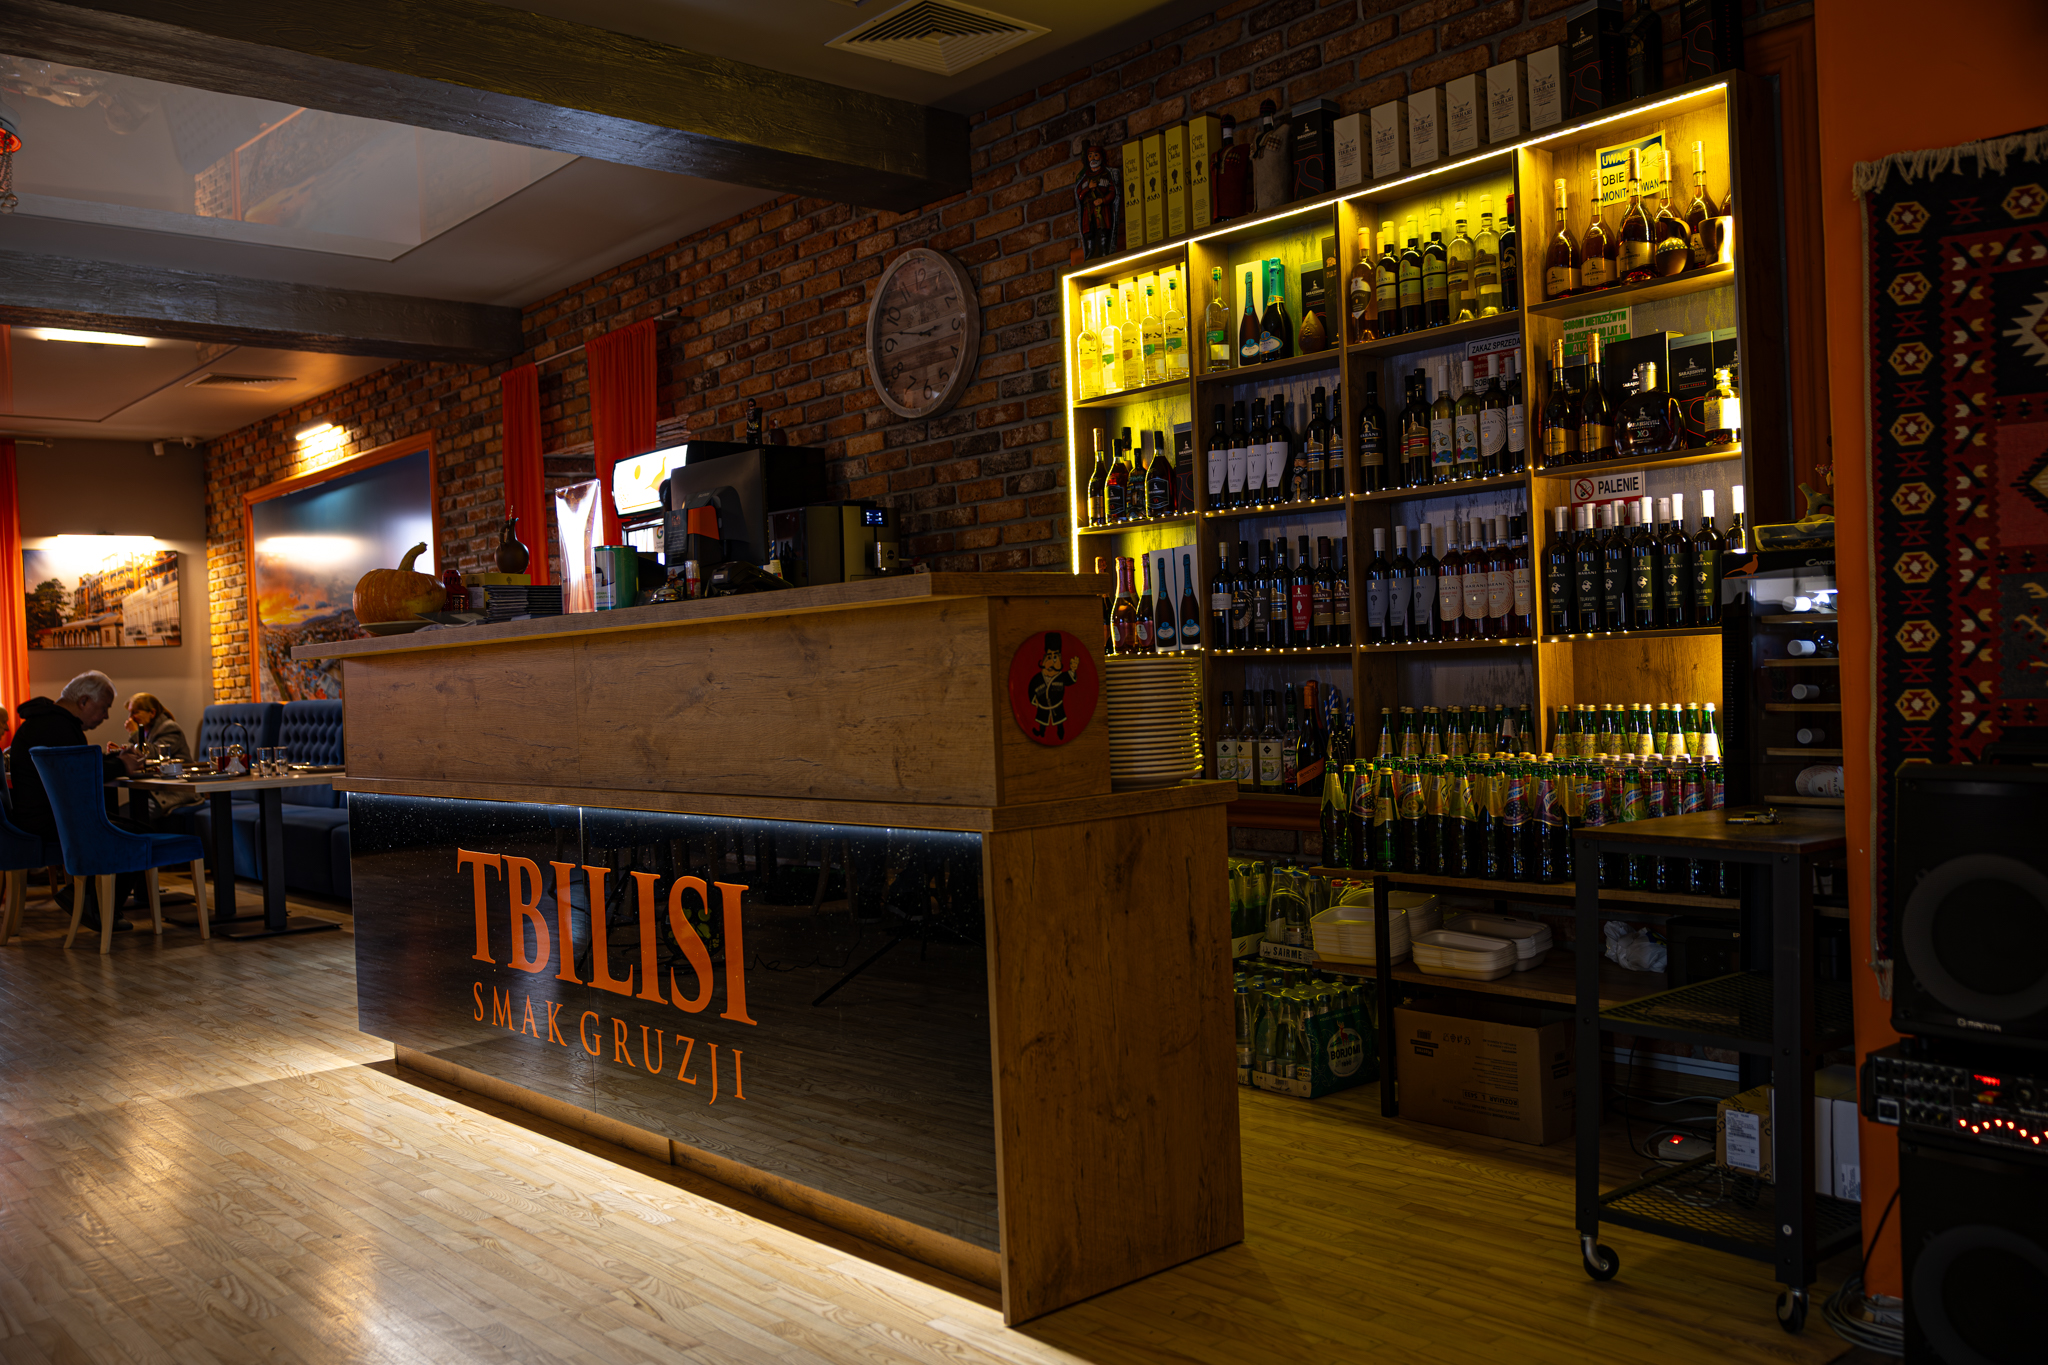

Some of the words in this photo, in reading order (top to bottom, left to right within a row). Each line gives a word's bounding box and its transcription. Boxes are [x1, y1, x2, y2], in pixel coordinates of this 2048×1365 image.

[914, 268, 926, 291] 12
[901, 282, 910, 302] 11
[887, 306, 901, 326] 10
[951, 318, 960, 330] 3
[1607, 325, 1618, 336] LAT
[1619, 324, 1626, 333] 18
[885, 338, 899, 353] 9
[1472, 343, 1491, 353] ZAKAZ
[891, 362, 903, 380] 8
[938, 367, 950, 380] 5
[905, 375, 917, 394] 7
[923, 379, 933, 400] 6
[1598, 477, 1639, 494] PALENIE
[457, 848, 757, 1026] TBILISI
[473, 981, 568, 1047] SMAK
[580, 1010, 746, 1105] GRUZJI
[1331, 1045, 1360, 1060] BORJOMI
[1489, 1096, 1518, 1106] ROZMIAR
